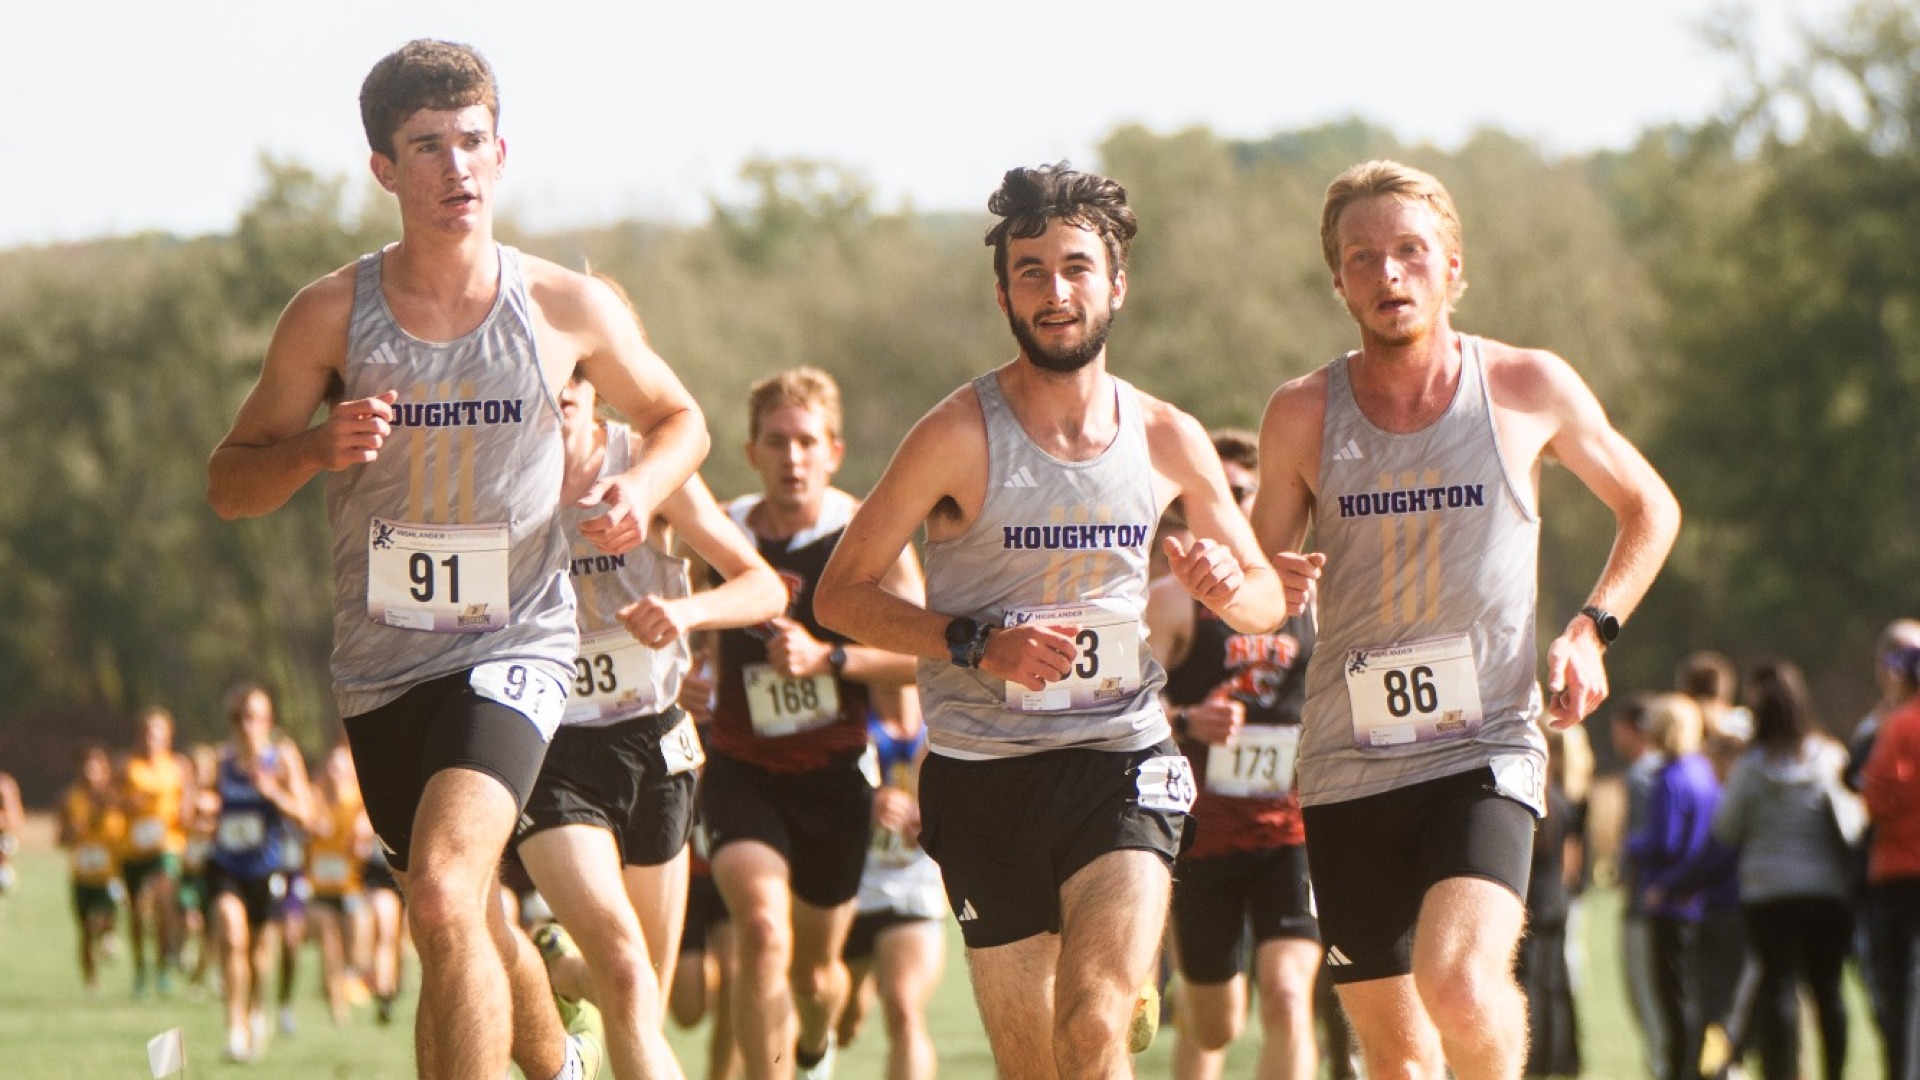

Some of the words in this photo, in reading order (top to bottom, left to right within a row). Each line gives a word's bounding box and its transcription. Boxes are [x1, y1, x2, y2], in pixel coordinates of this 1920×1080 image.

[389, 399, 523, 428] OUGHTON
[1337, 483, 1485, 518] HOUGHTON
[1003, 524, 1148, 550] HOUGHTON
[408, 552, 460, 603] 91
[1035, 610, 1083, 620] HIGHLANDER
[1059, 628, 1099, 679] 3
[573, 653, 617, 697] 93
[1383, 664, 1438, 718] 86
[767, 677, 820, 718] 168
[1231, 747, 1278, 780] 173
